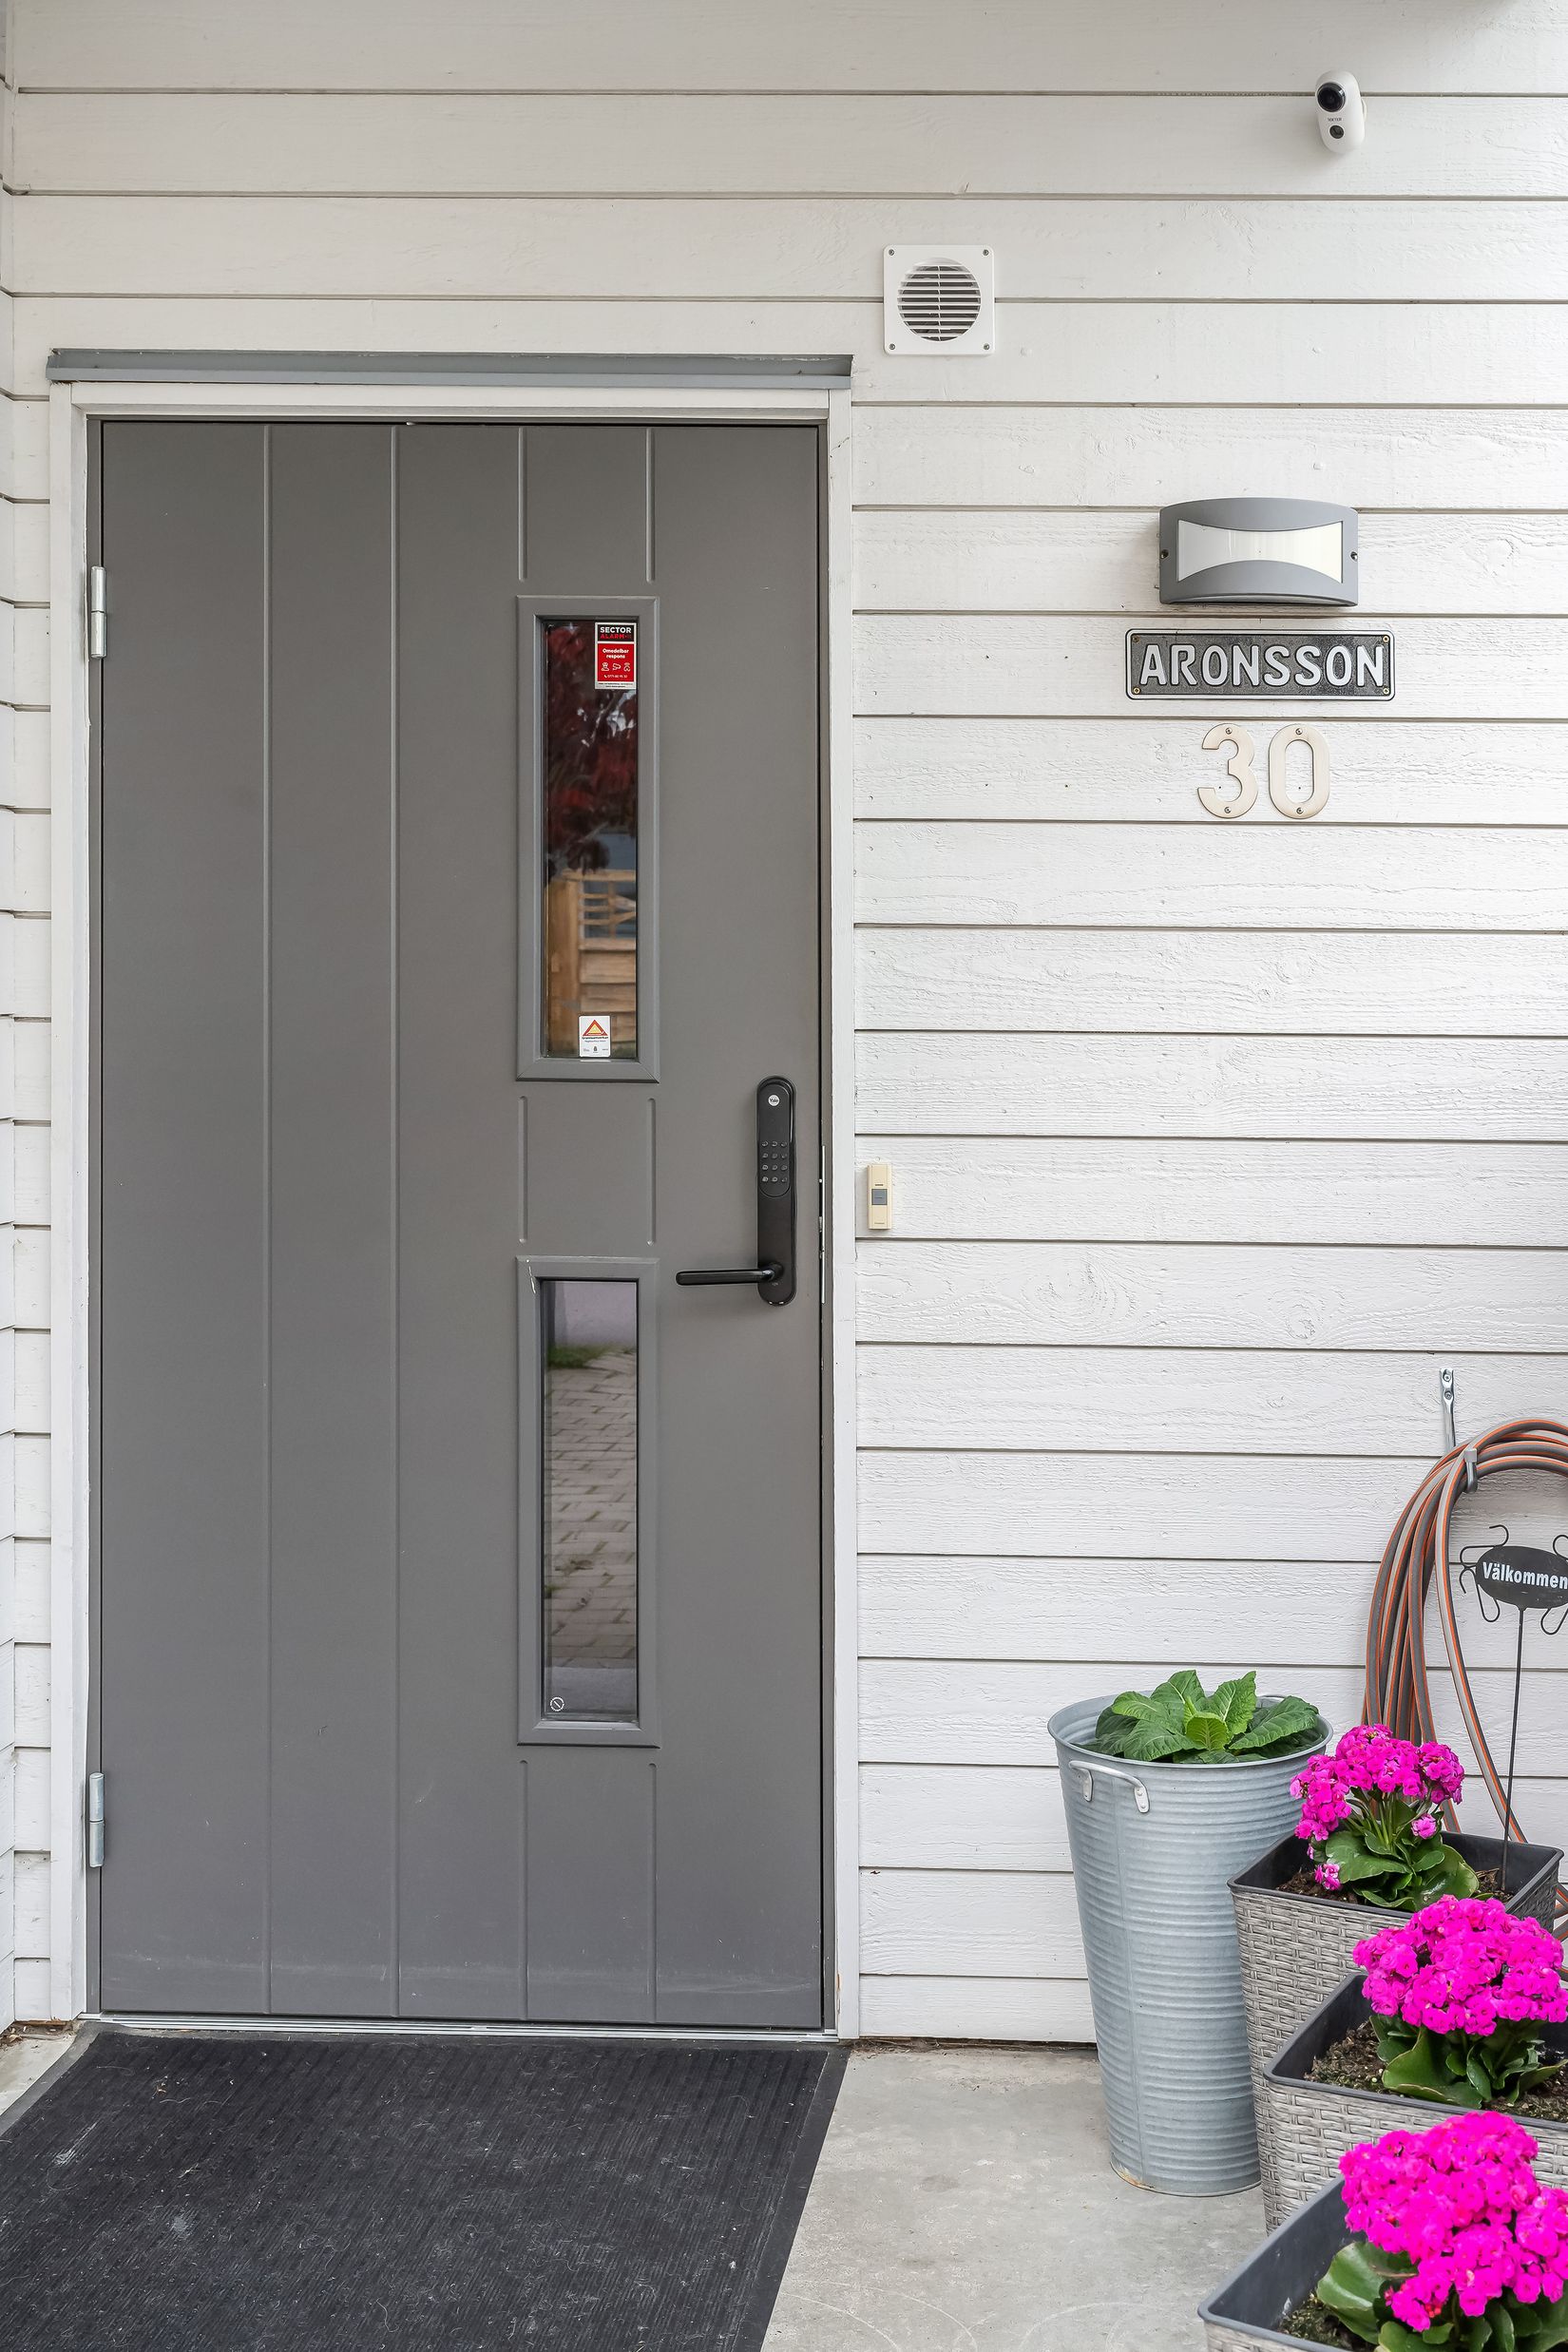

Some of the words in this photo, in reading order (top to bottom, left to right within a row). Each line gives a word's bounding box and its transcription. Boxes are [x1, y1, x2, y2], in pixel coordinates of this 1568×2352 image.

[1139, 643, 1385, 687] ARONSSON
[1196, 722, 1330, 819] 30
[1482, 1561, 1568, 1590] Välkommen
